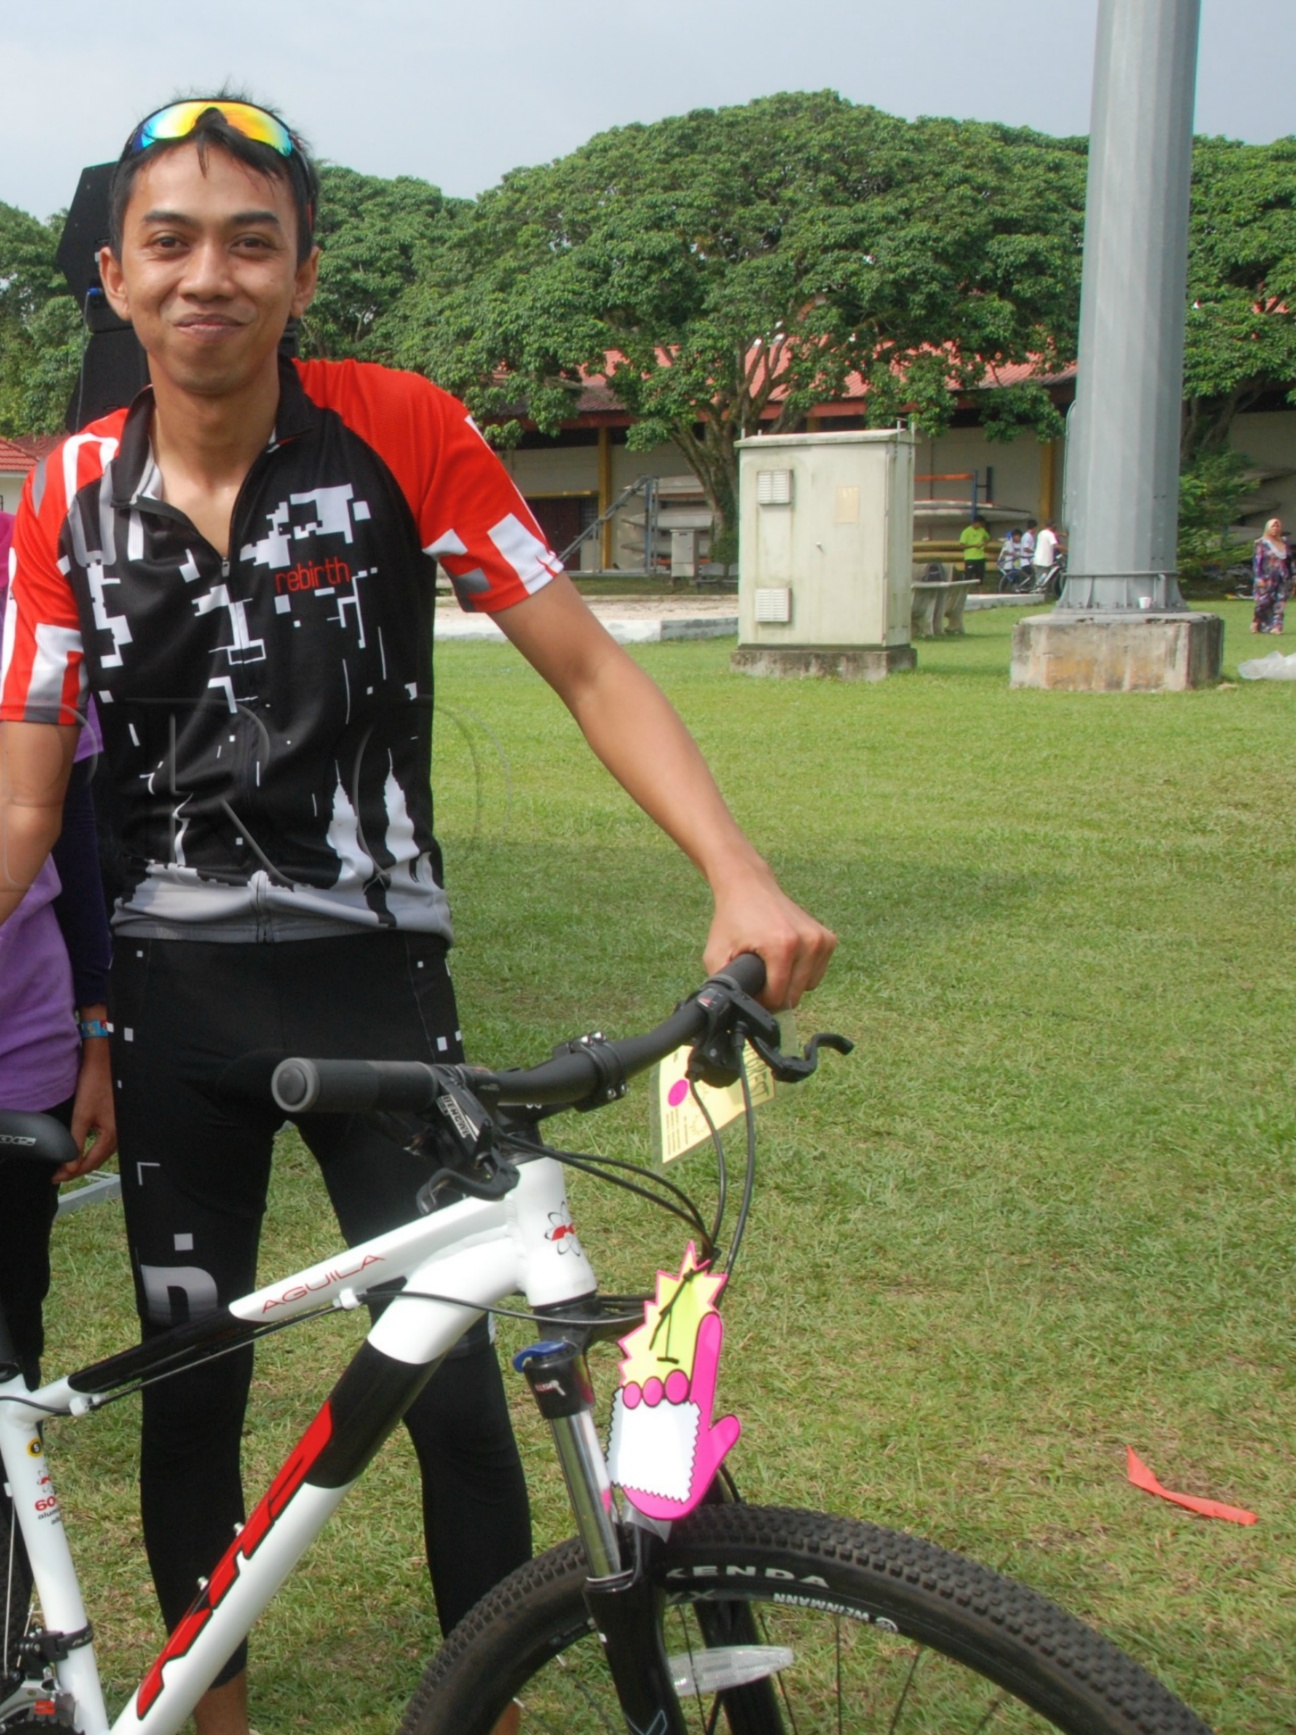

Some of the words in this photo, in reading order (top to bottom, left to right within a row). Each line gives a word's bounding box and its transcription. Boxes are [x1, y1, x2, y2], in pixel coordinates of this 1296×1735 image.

[275, 556, 351, 594] rebirth
[262, 1255, 387, 1314] AGUILA
[34, 1495, 57, 1512] 60
[666, 1565, 830, 1589] KENDA
[773, 1592, 871, 1622] WEINMANN
